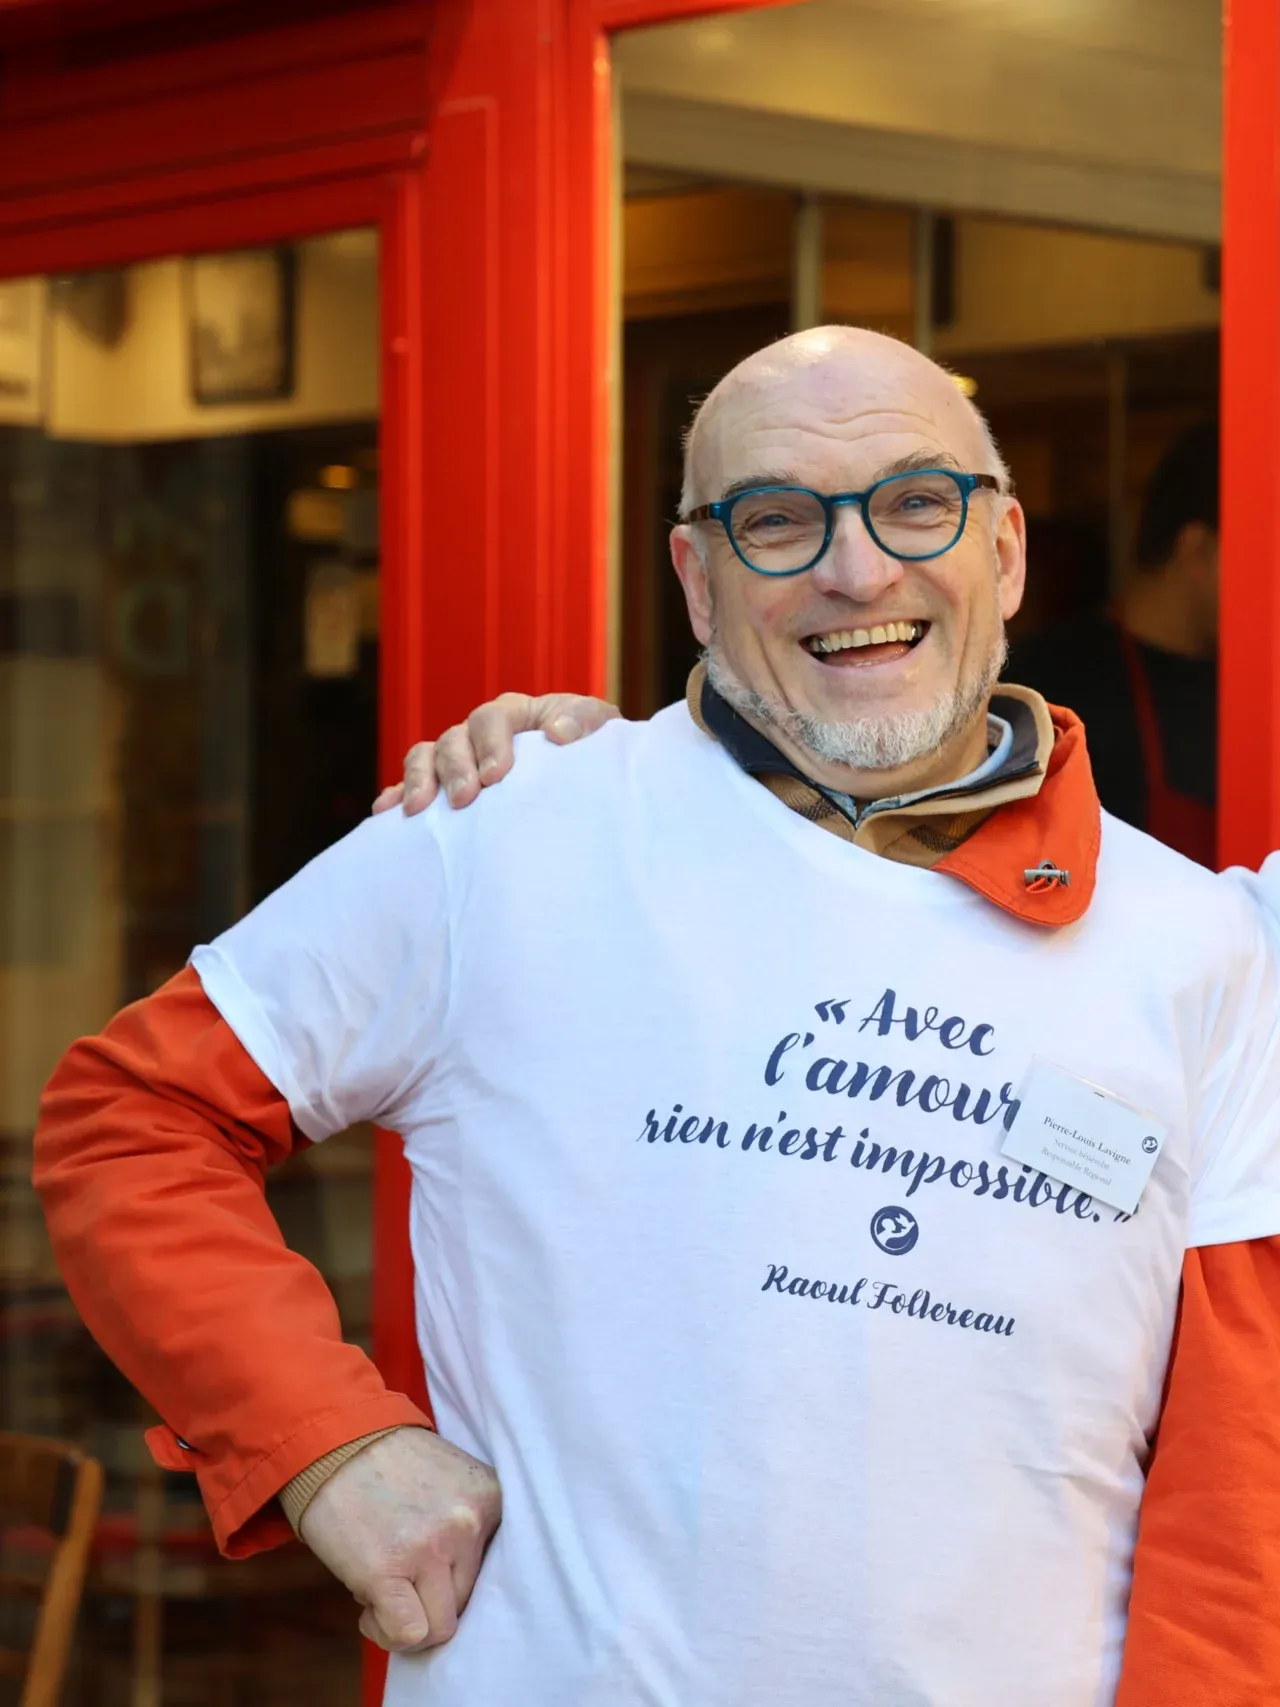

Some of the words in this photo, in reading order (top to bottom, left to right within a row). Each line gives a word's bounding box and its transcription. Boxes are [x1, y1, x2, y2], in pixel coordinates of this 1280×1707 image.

[858, 988, 995, 1056] Avec
[637, 1103, 732, 1149] rien
[741, 1111, 846, 1163] n'est
[851, 1128, 1102, 1223] impossible.
[1043, 1116, 1096, 1148] Pierre-Louis
[1098, 1142, 1131, 1165] Lavigne
[760, 1263, 868, 1306] Raoul
[867, 1283, 1016, 1337] Follereau
